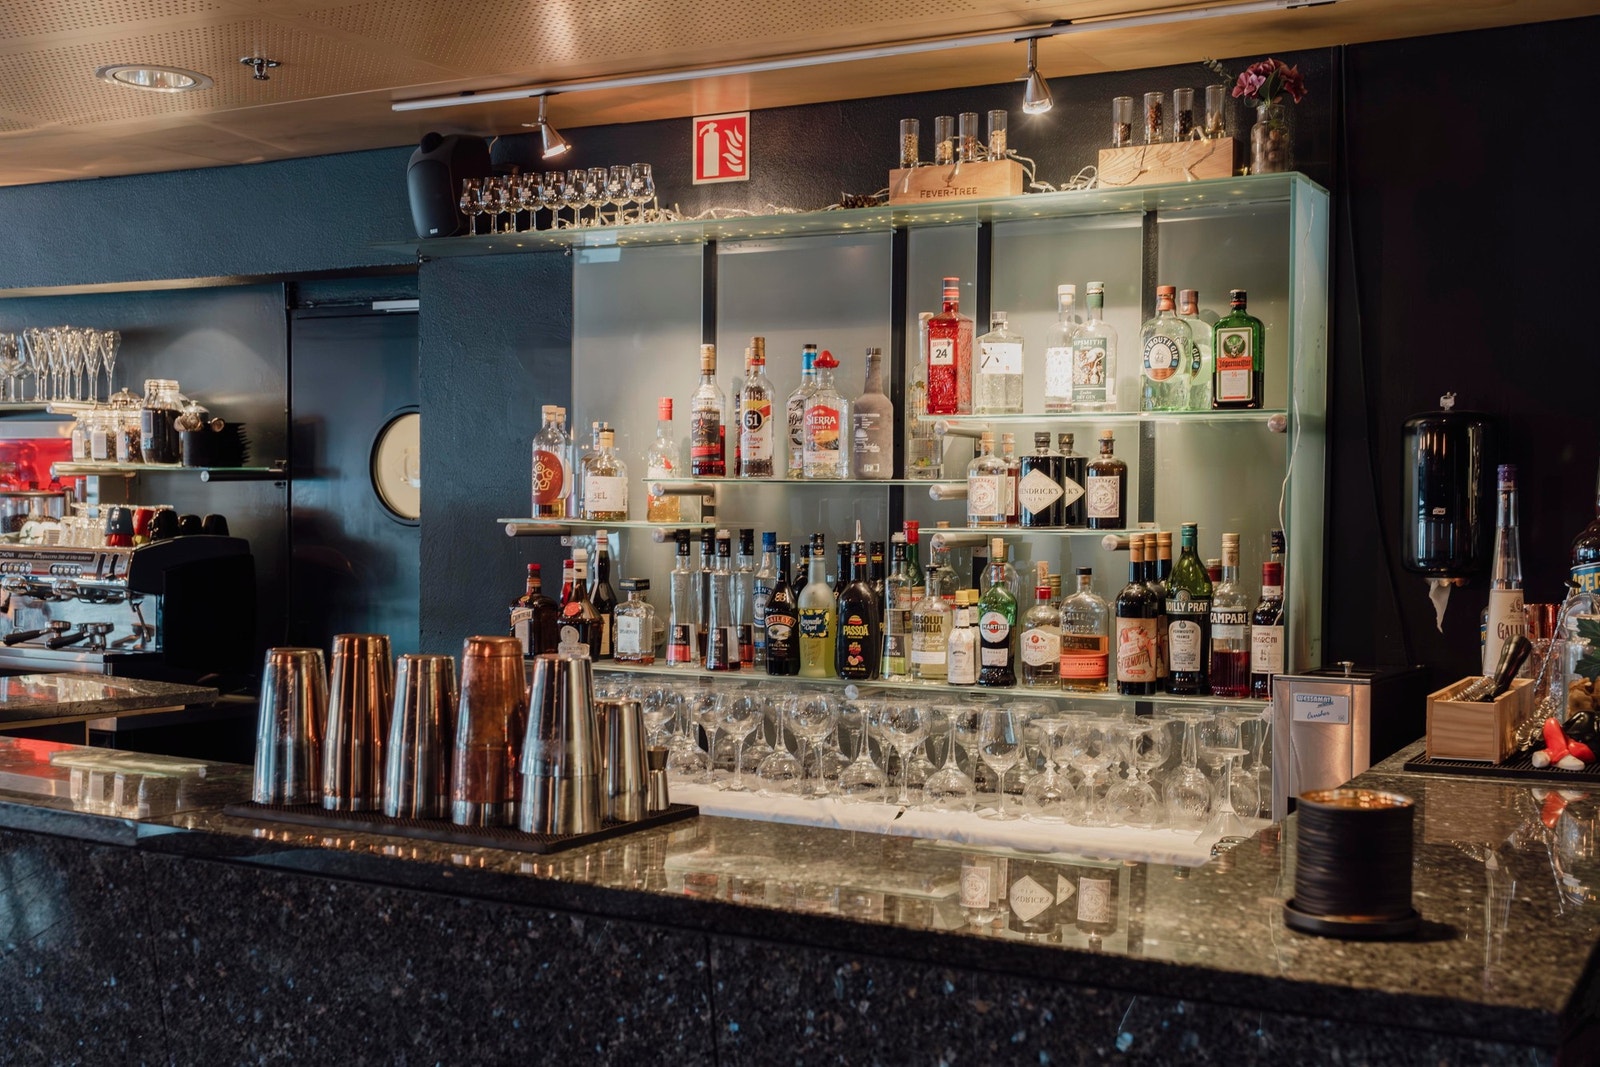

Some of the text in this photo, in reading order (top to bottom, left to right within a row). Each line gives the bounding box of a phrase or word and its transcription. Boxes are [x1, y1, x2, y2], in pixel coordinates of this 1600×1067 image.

[919, 186, 978, 199] FEVER-TREE
[935, 349, 948, 359] 24
[1144, 336, 1179, 360] PLYMOUTH GIN
[746, 414, 759, 426] 51
[806, 413, 837, 425] SIERRA
[1187, 602, 1208, 611] PRAT
[1210, 612, 1247, 624] CAMPARI
